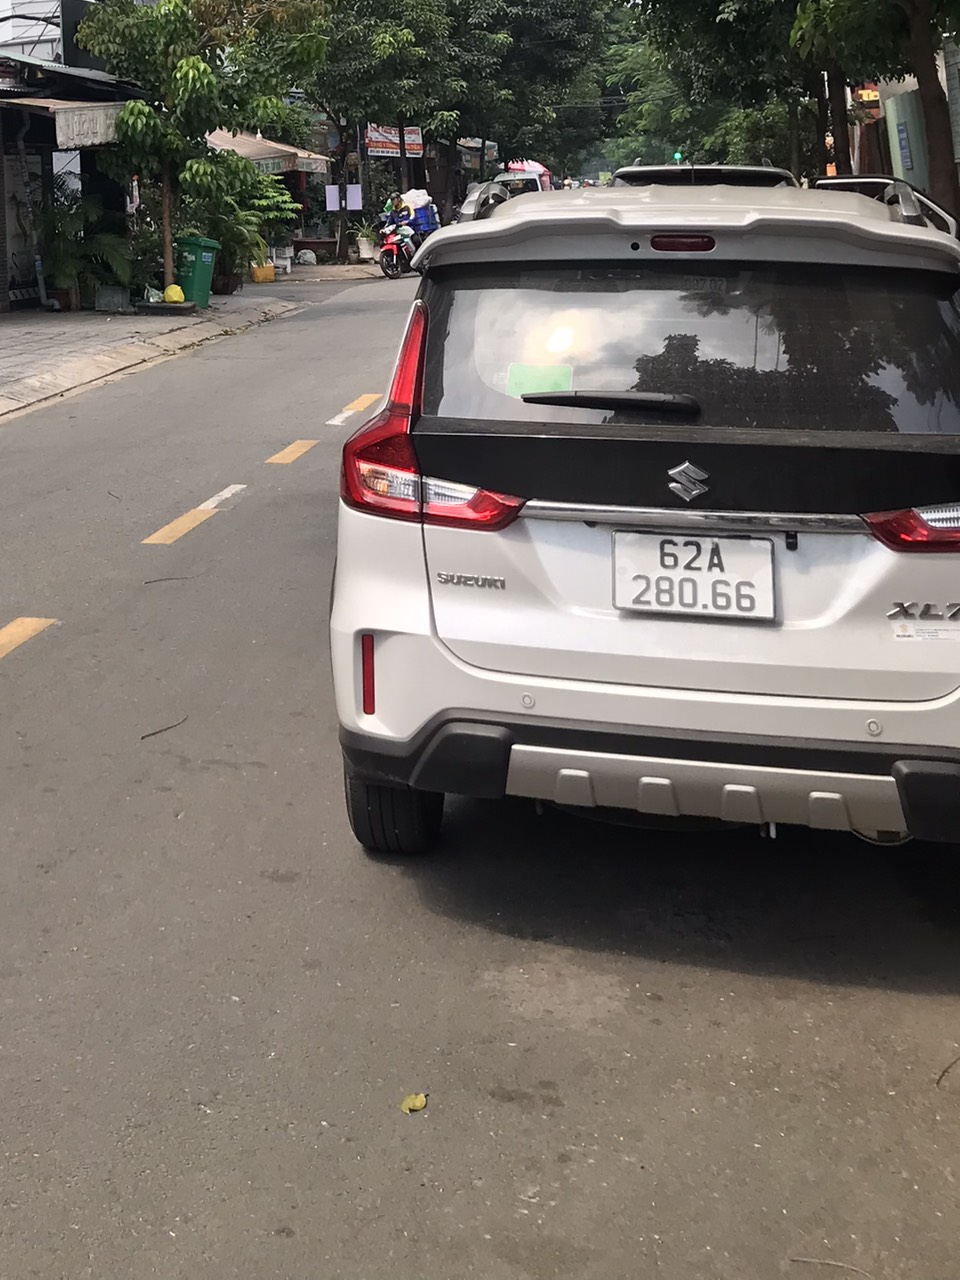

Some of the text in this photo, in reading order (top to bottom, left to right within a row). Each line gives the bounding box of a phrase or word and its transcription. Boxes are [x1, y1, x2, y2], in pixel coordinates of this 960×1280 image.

[659, 538, 726, 573] 62A
[437, 571, 506, 591] SUZUKI
[631, 574, 756, 612] 280.66
